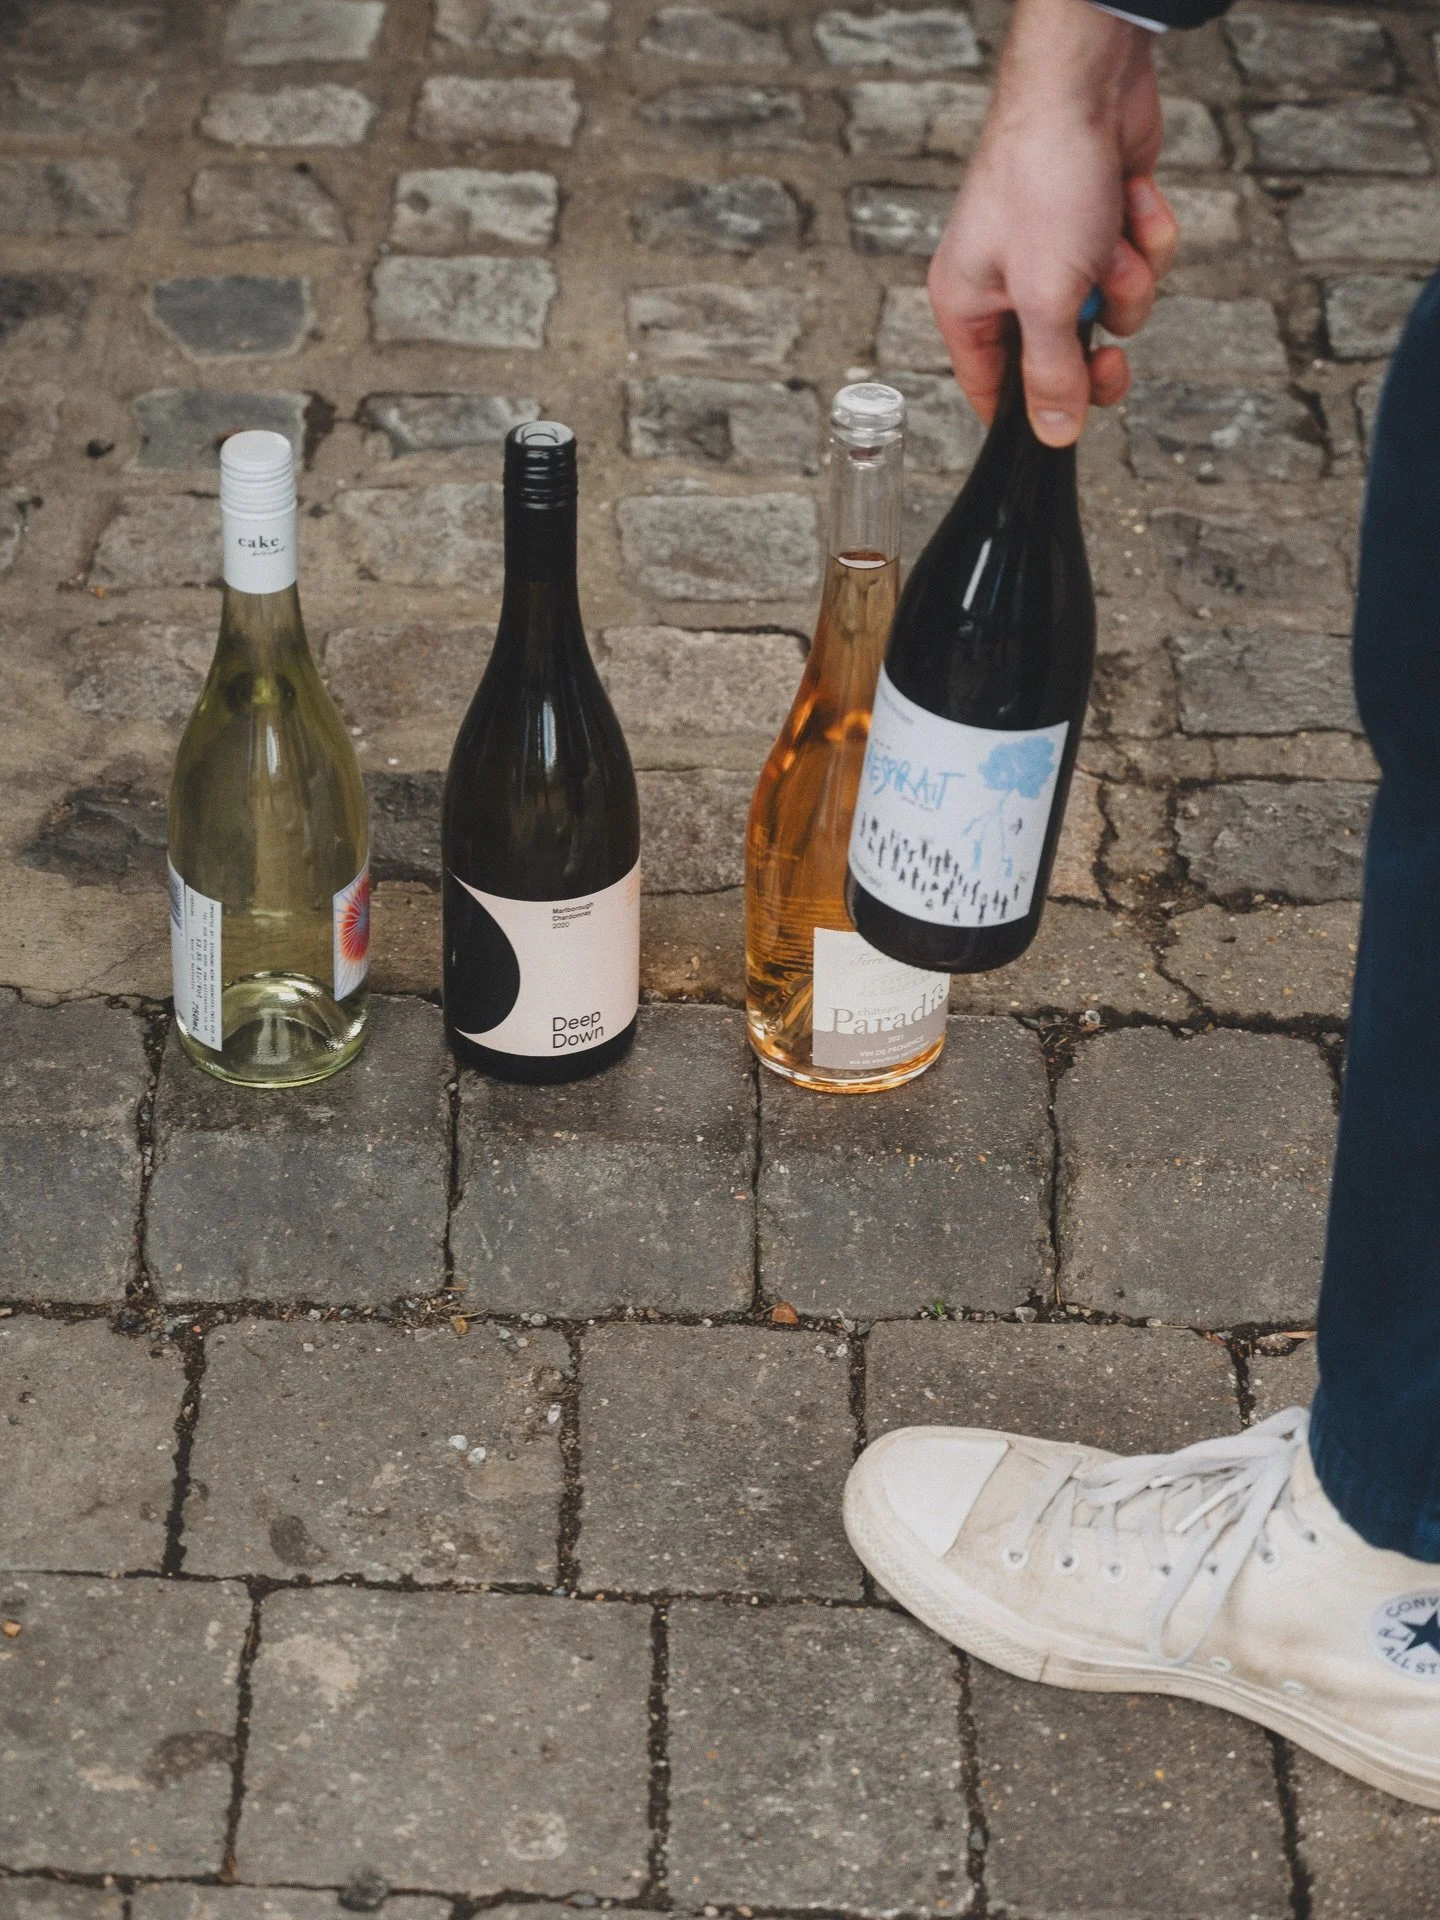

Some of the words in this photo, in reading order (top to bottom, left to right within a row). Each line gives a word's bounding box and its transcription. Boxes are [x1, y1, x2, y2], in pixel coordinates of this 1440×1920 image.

[238, 535, 280, 548] cake
[552, 902, 594, 914] Marlborough
[552, 910, 592, 922] Chardonnay
[552, 921, 570, 929] 2020
[552, 1011, 602, 1032] Deep
[552, 1026, 604, 1048] Down
[1382, 1646, 1410, 1669] ALL
